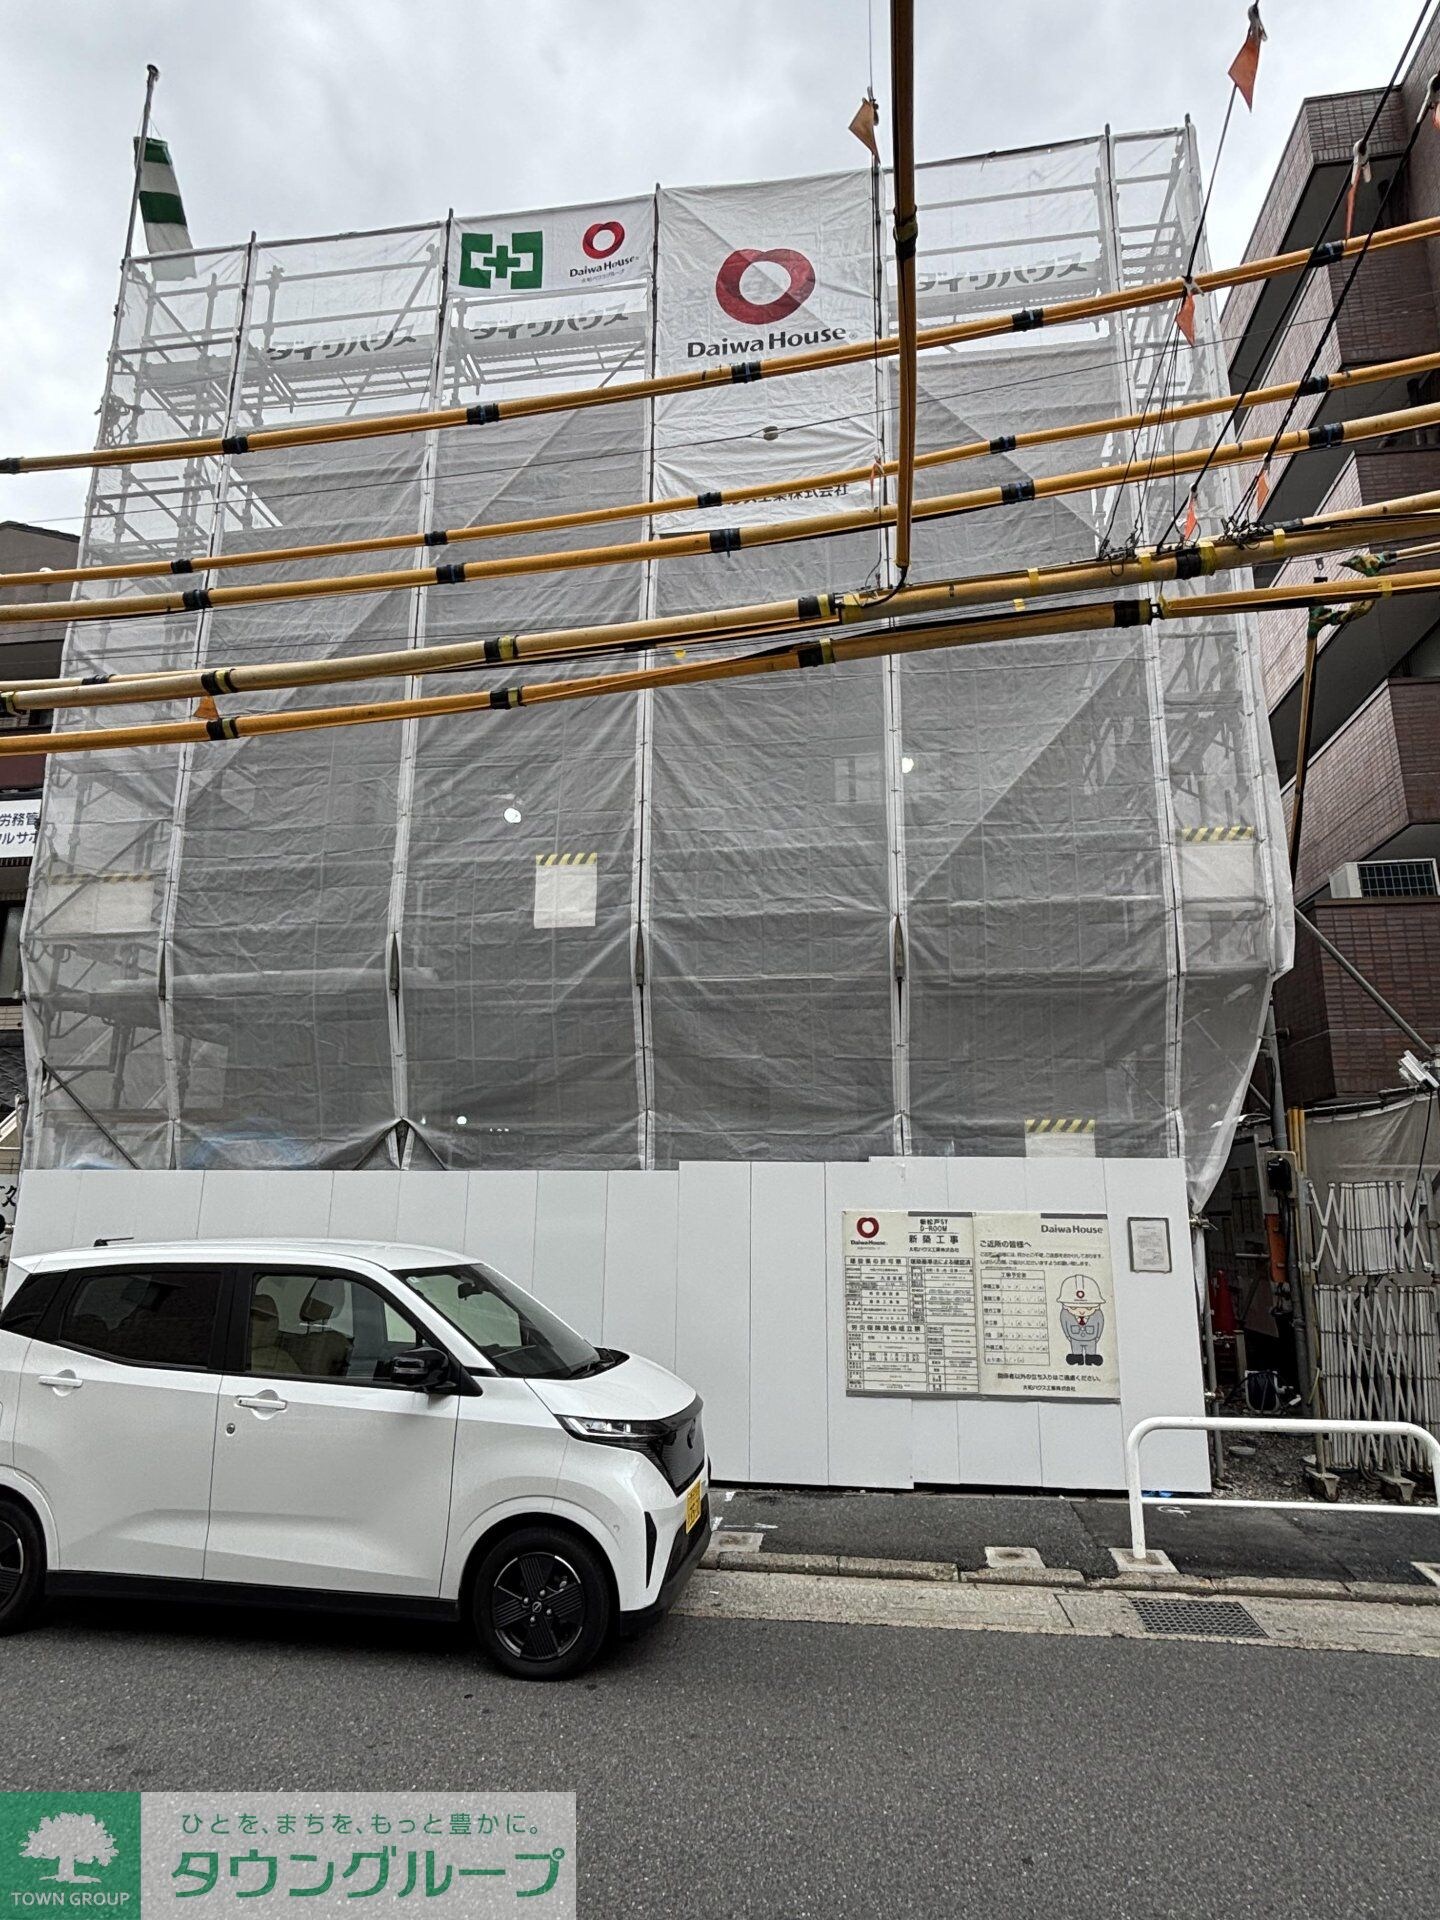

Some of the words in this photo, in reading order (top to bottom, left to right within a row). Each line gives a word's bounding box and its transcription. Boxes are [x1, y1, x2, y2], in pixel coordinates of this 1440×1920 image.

[569, 265, 602, 278] Daiwa
[603, 256, 635, 270] House
[687, 338, 764, 358] Daiwa
[768, 327, 847, 350] House
[1040, 1223, 1071, 1234] Daiwa
[1072, 1224, 1103, 1234] House
[908, 1234, 959, 1245] 新築工事
[979, 1239, 1032, 1249] ご近所の皆様へ
